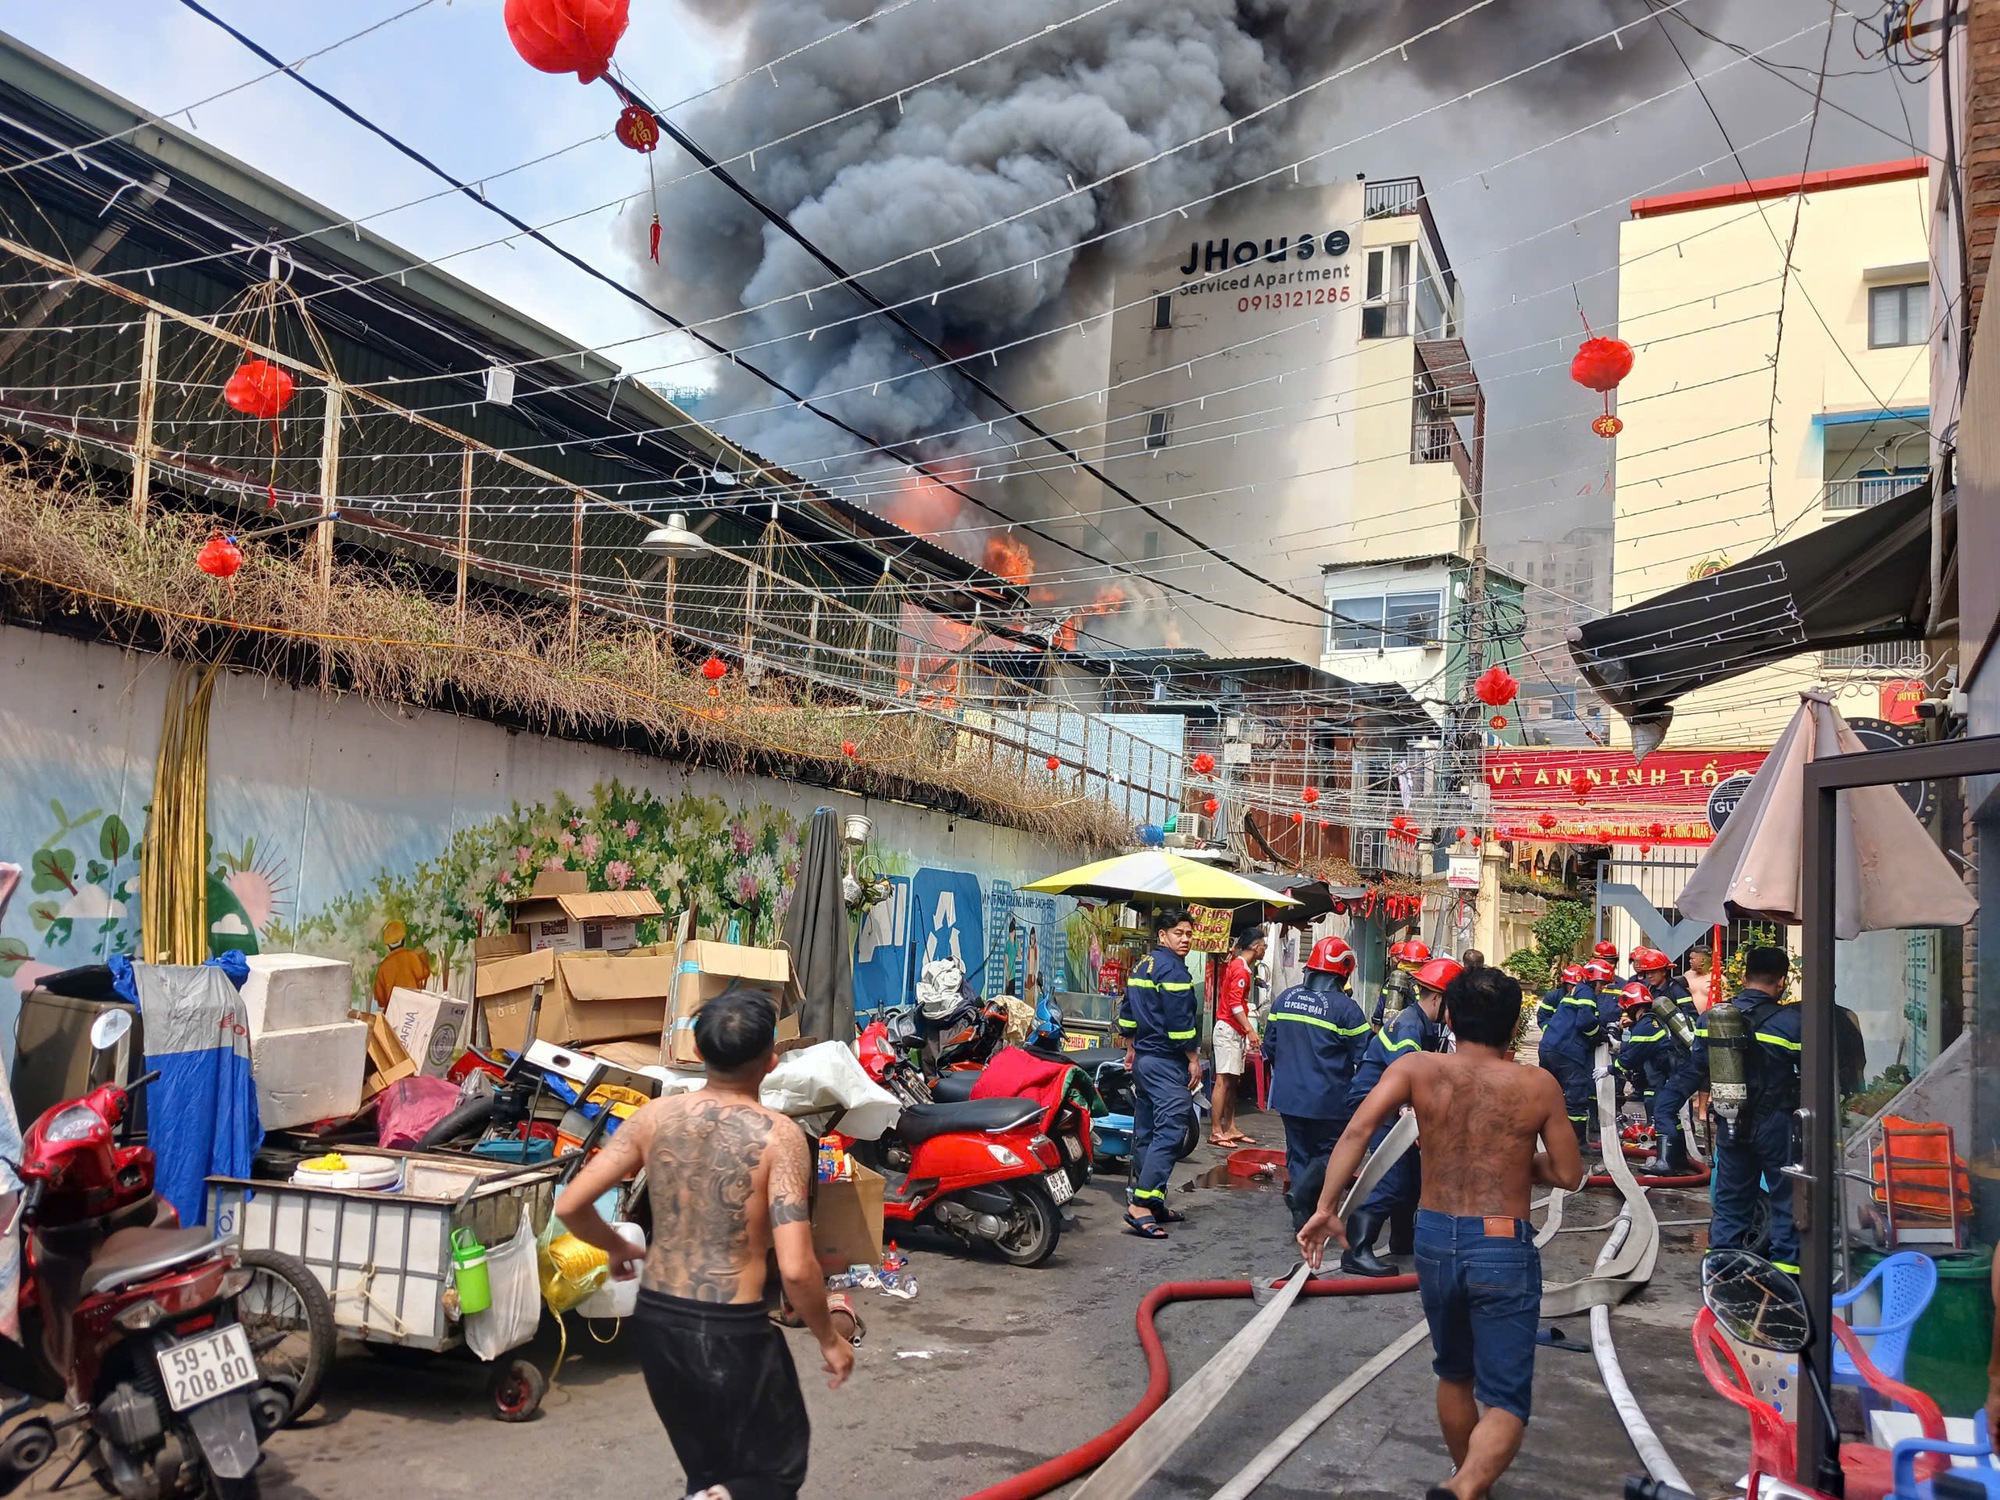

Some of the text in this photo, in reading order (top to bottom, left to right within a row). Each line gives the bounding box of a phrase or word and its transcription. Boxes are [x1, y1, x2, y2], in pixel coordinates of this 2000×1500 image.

[629, 115, 652, 145] 福
[1180, 230, 1350, 275] JHouse
[1179, 264, 1350, 296] Serviced Apartment
[1238, 286, 1350, 313] 0913121285
[1599, 419, 1615, 433] 福
[1491, 759, 1719, 787] VÌ AN NINH TỔ
[172, 1333, 236, 1375] 59-TA
[175, 1356, 249, 1405] 208.80
